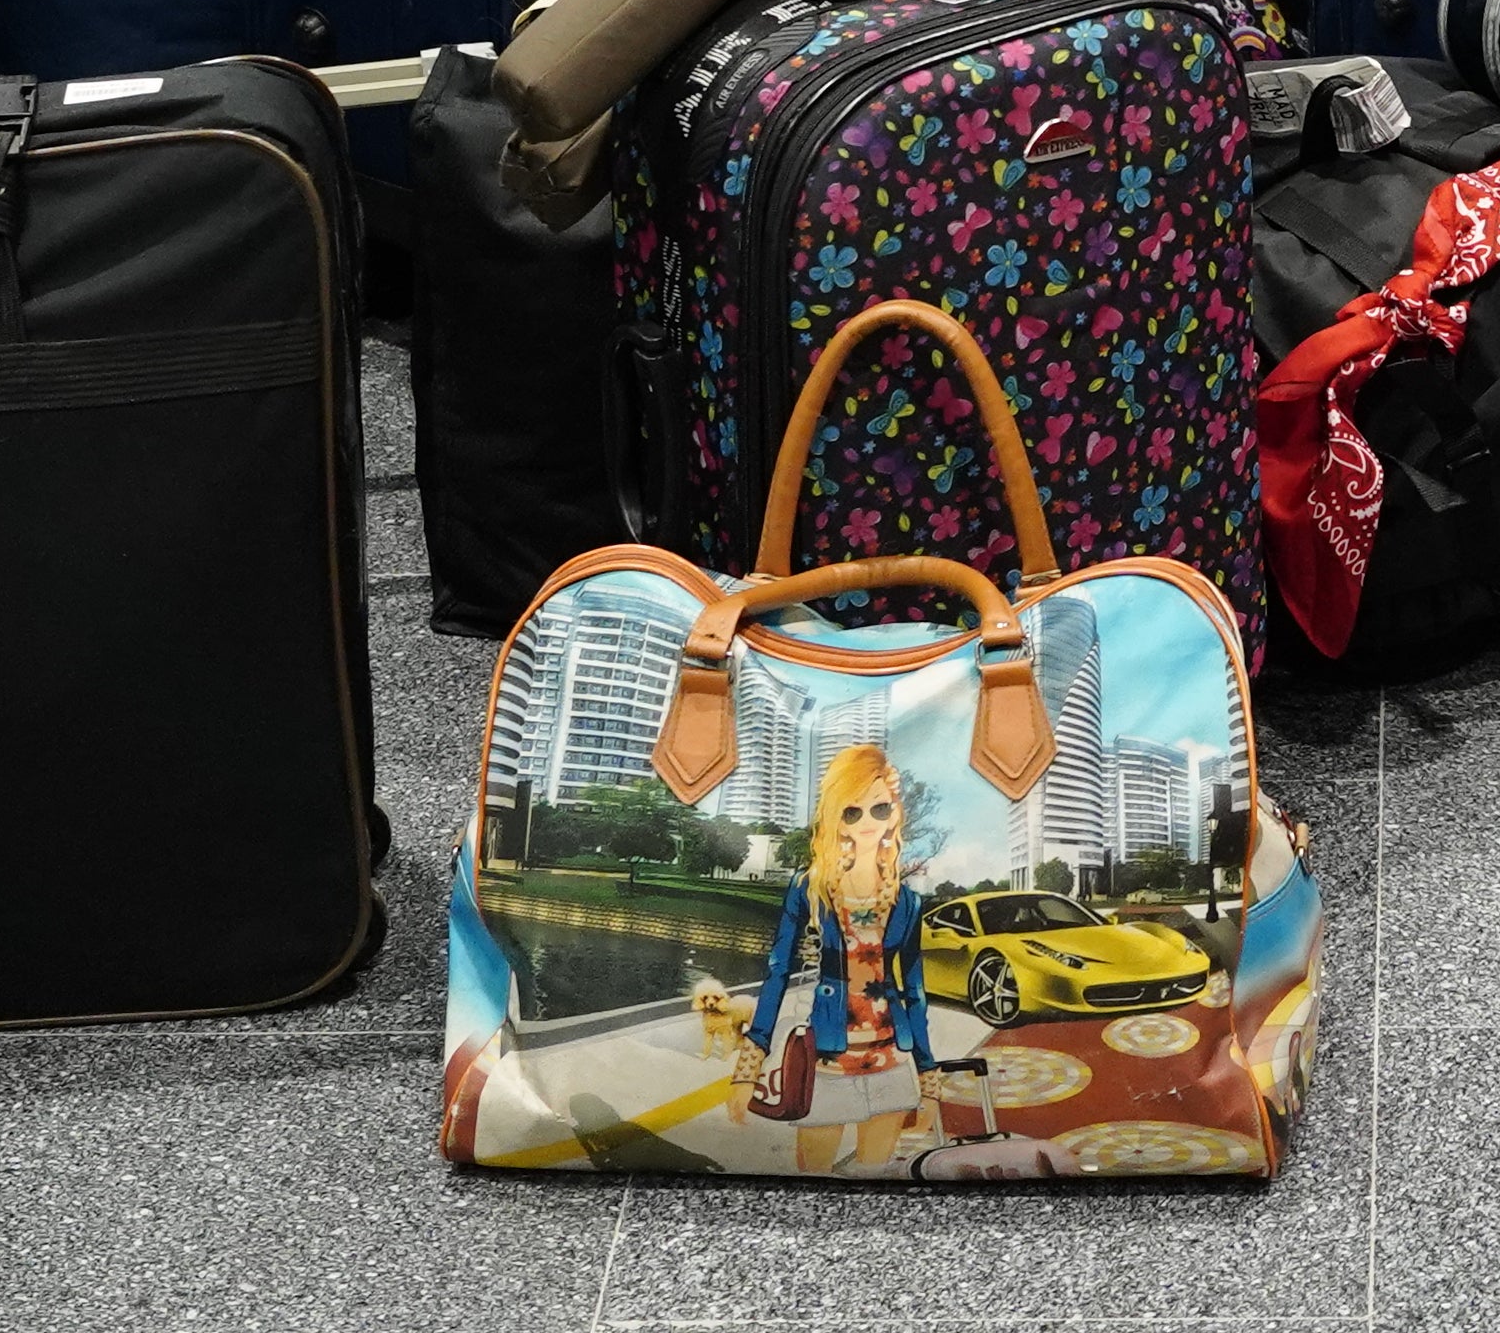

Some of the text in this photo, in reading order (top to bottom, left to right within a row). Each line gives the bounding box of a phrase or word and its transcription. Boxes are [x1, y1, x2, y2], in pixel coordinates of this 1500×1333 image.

[715, 51, 765, 109] AIR EXPRESS
[1268, 88, 1296, 119] MAD
